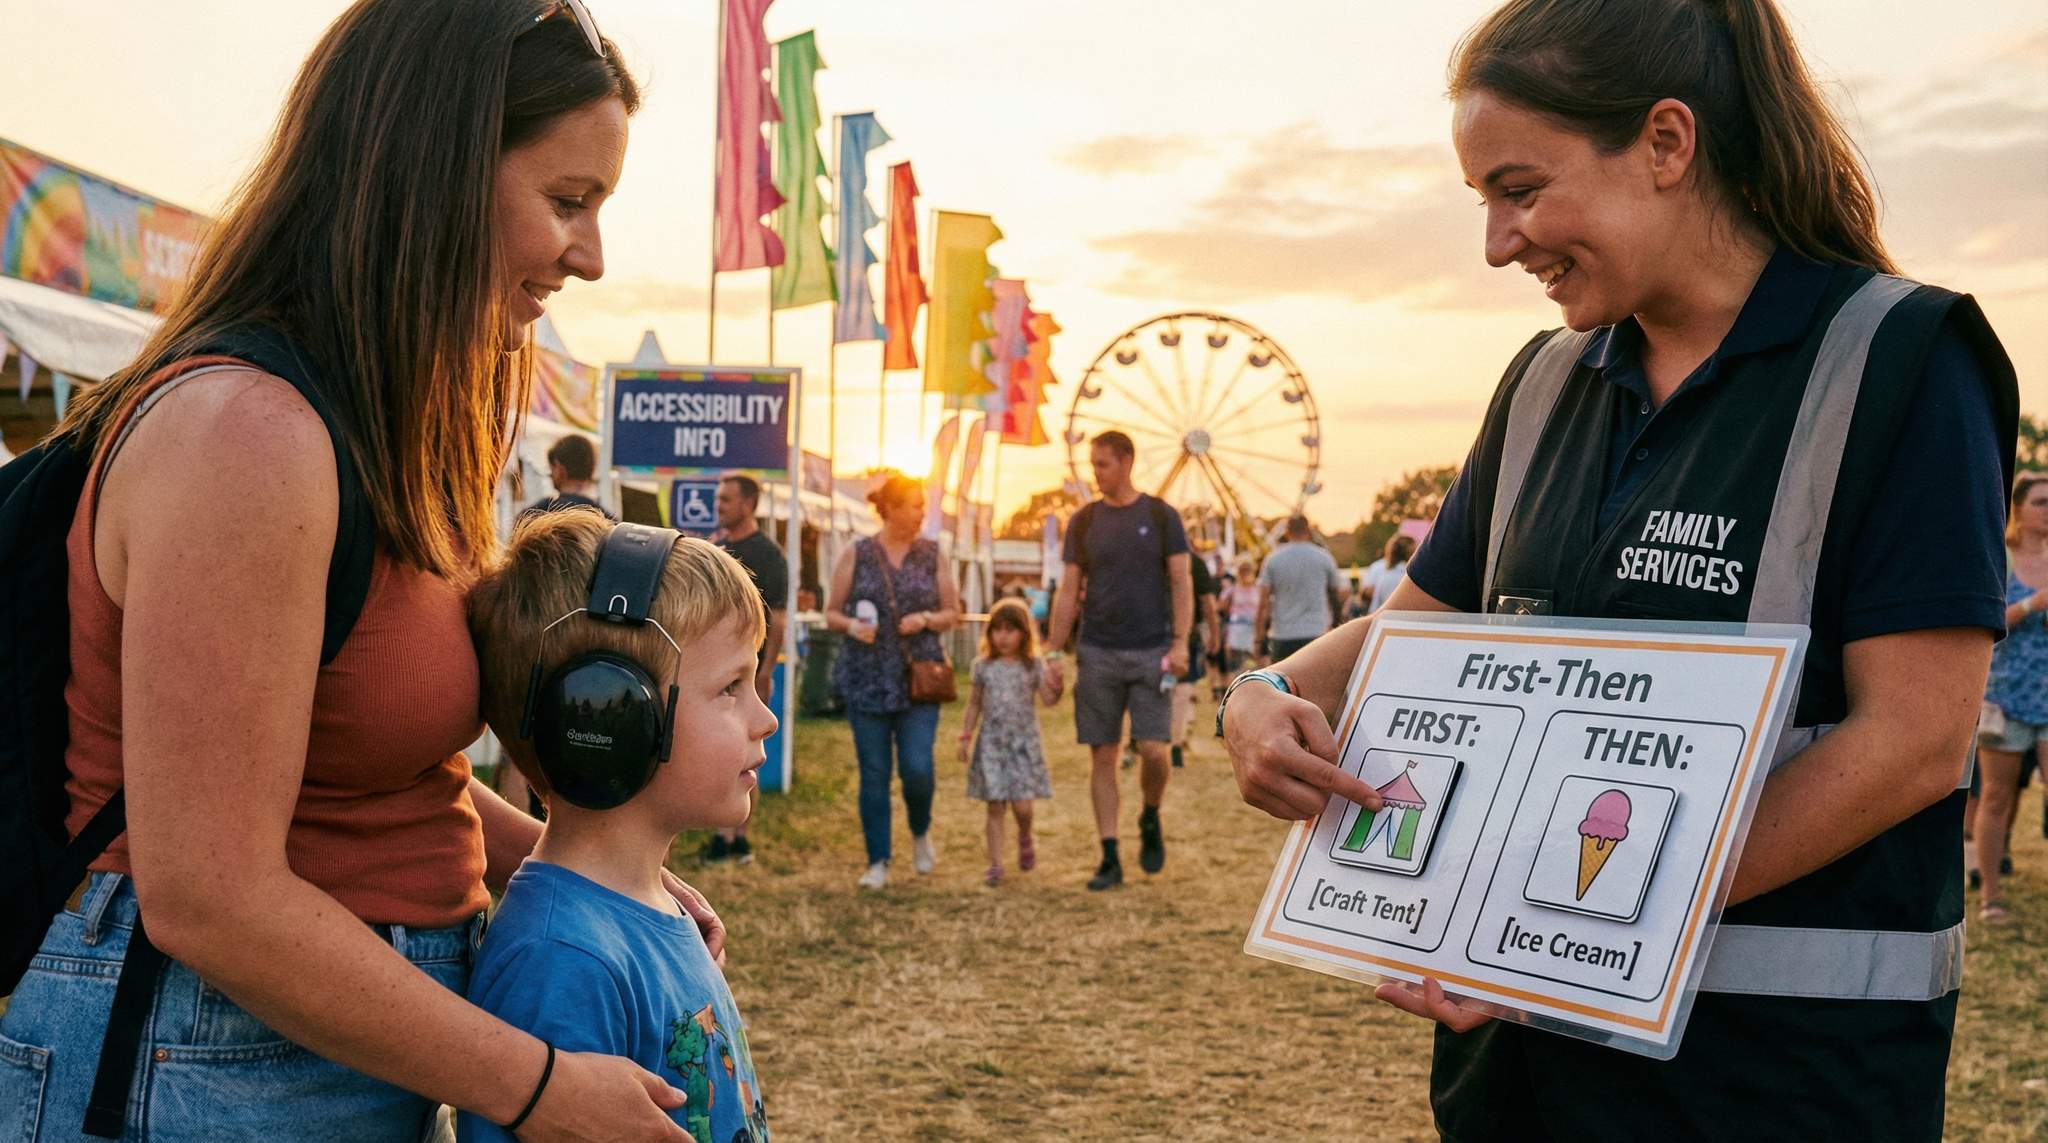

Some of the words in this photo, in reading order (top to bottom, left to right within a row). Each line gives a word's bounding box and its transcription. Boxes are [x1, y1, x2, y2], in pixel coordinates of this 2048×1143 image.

[619, 392, 783, 425] ACCESSIBILITY
[674, 427, 726, 457] INFO
[1640, 510, 1738, 551] FAMILY
[1616, 546, 1743, 595] SERVICES
[1457, 653, 1653, 703] First-Then
[1386, 708, 1481, 748] FIRST:
[1583, 726, 1693, 770] THEN:
[1307, 878, 1369, 914] [Craft
[1371, 894, 1428, 934] Tent]
[1497, 916, 1544, 955] [Ice
[1549, 932, 1642, 981] Cream]
